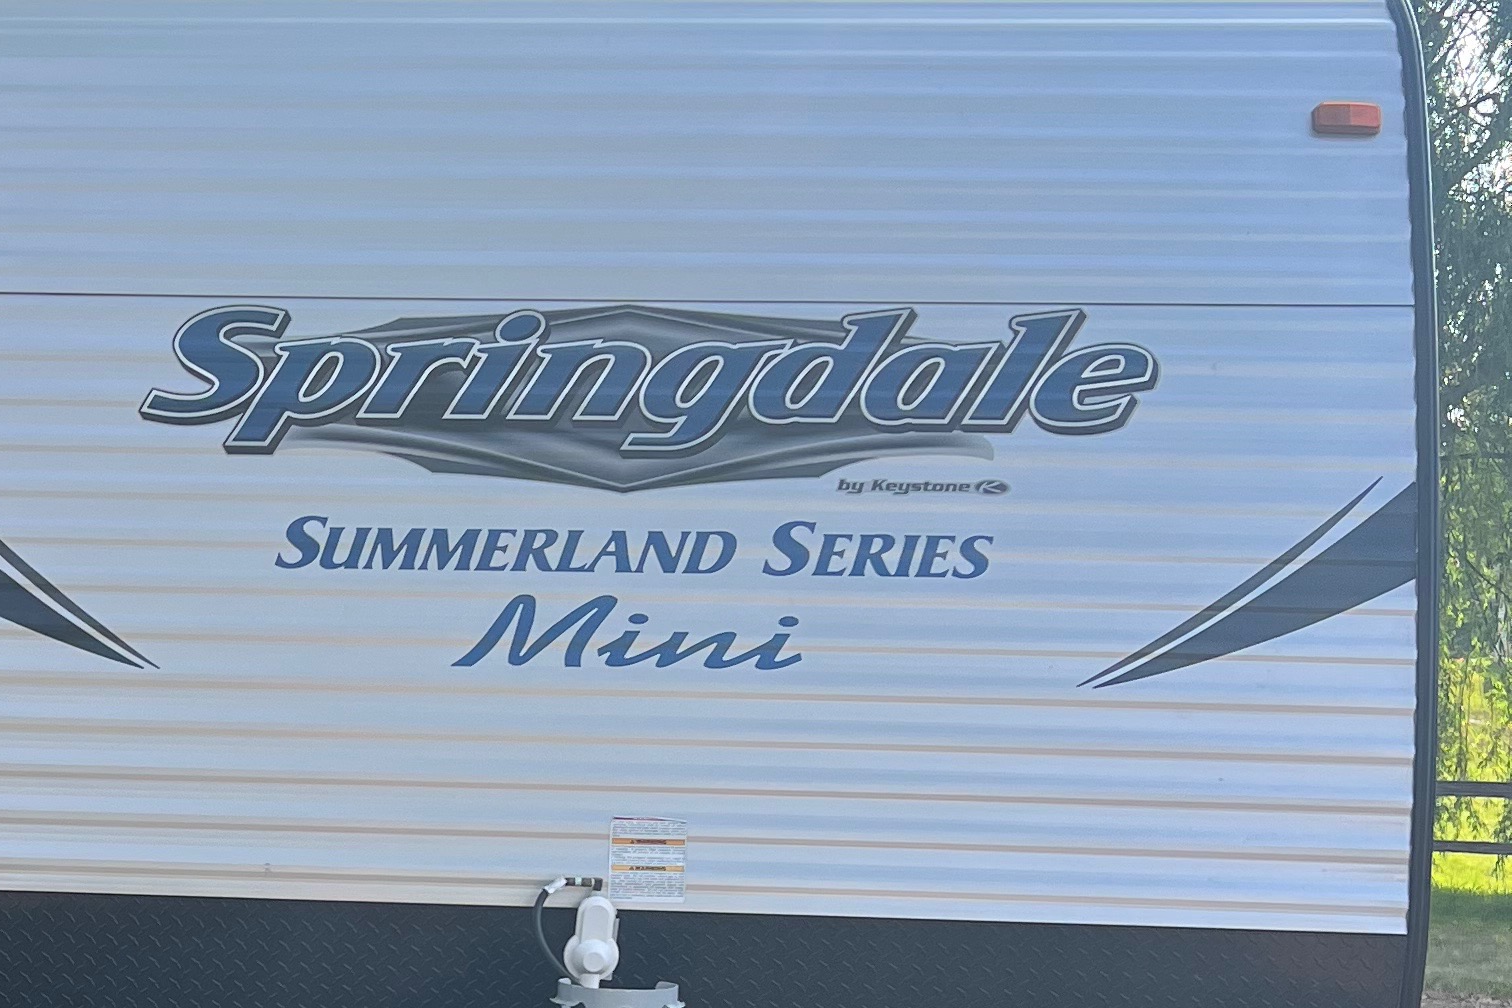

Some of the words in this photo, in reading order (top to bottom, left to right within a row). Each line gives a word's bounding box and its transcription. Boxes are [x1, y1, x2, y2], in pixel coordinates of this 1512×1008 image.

[139, 305, 1160, 458] Springdale
[837, 479, 865, 494] by
[871, 479, 970, 495] Keystone
[274, 515, 737, 574] SUMMERLAND
[763, 521, 994, 579] SERIES
[451, 594, 802, 670] Mini
